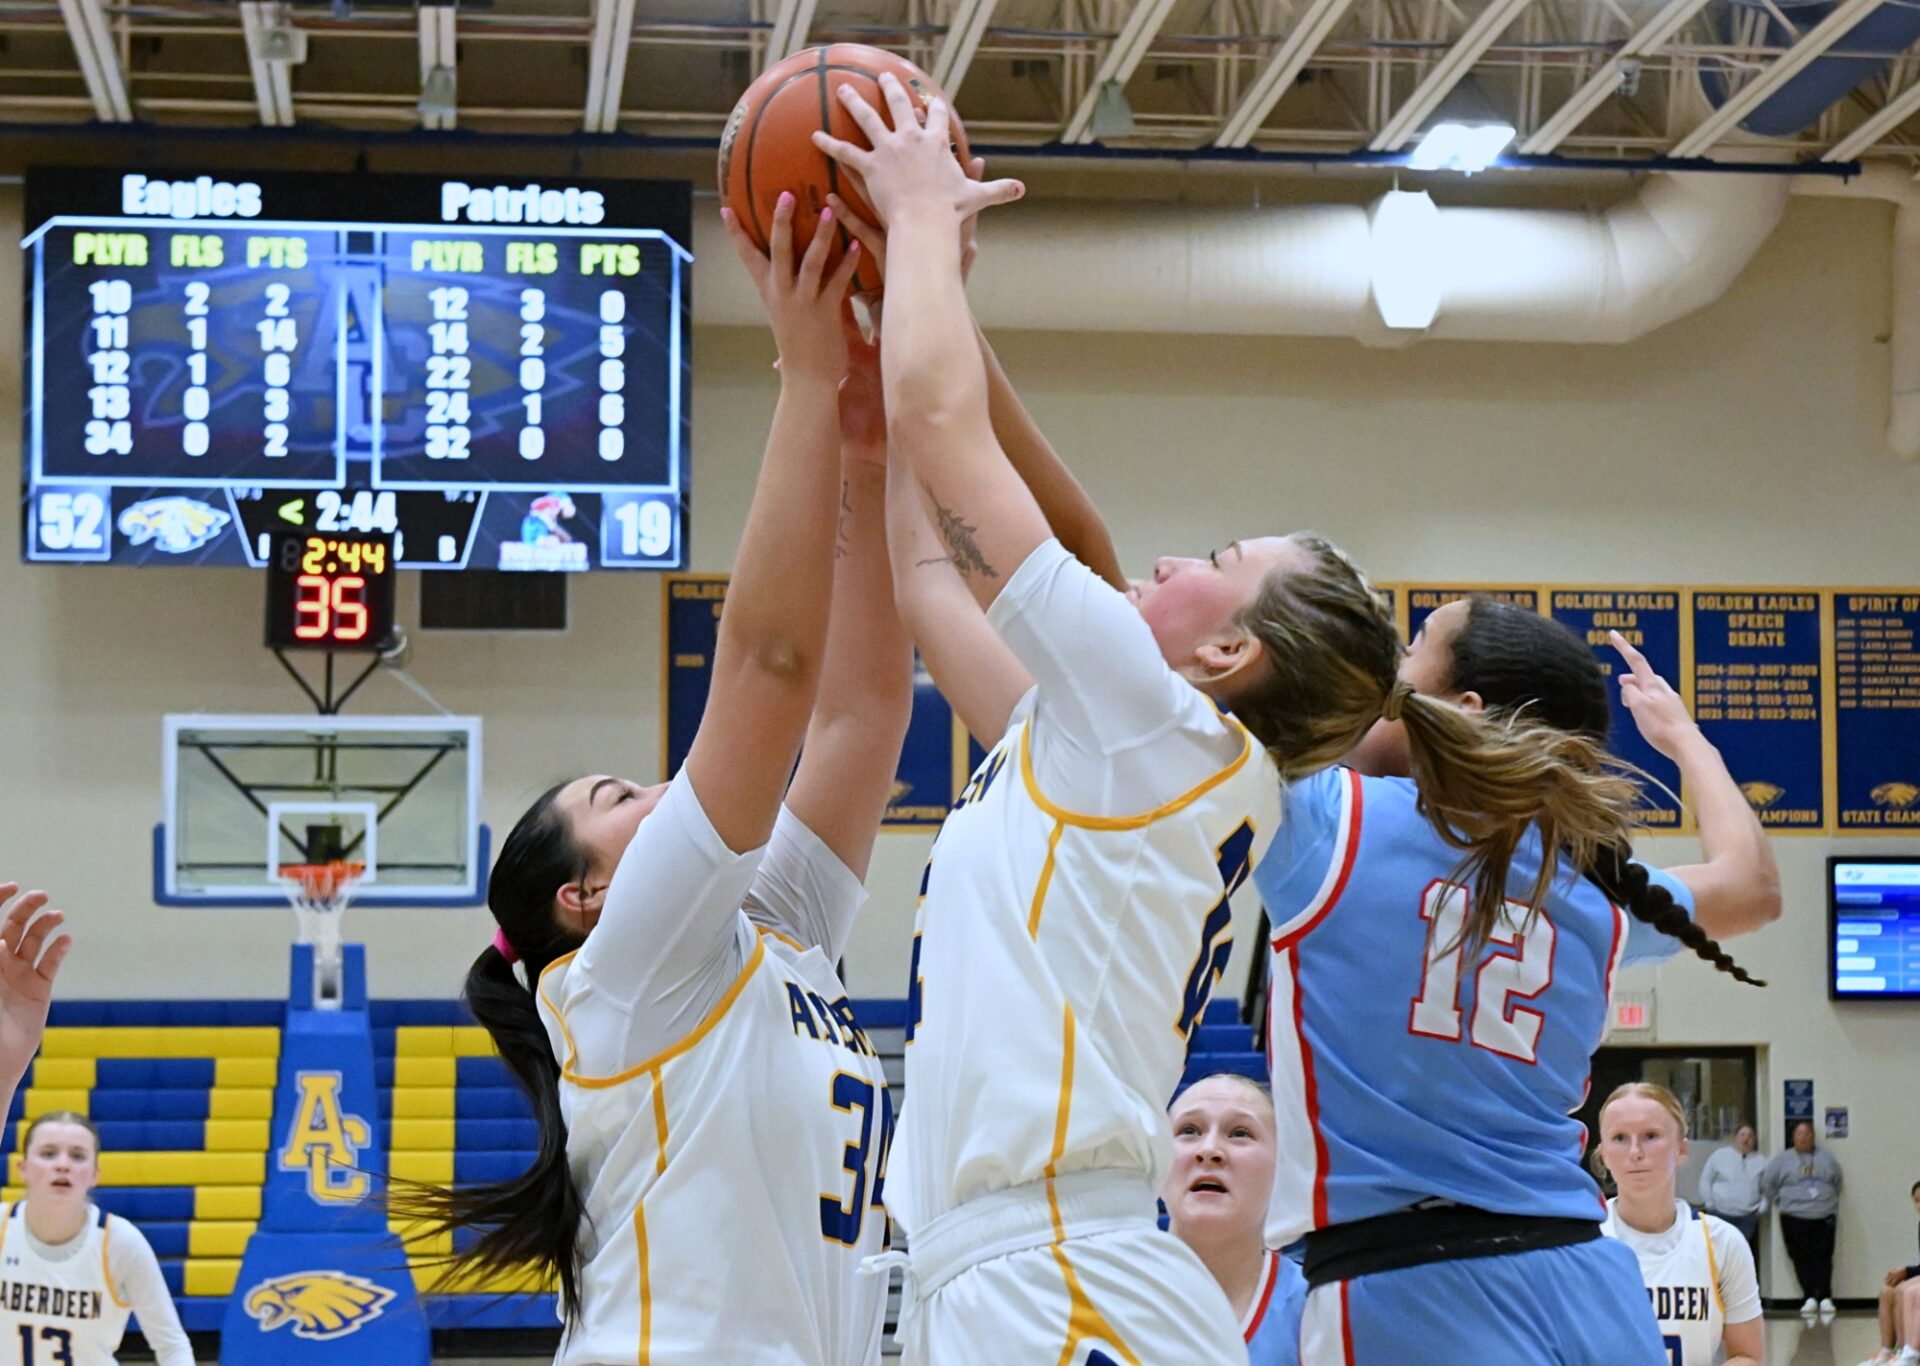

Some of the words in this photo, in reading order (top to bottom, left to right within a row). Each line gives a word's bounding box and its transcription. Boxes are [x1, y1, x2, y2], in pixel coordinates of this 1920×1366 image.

[122, 174, 262, 219] Eagles
[441, 182, 605, 224] Patriots
[73, 232, 148, 266] PLYR
[170, 234, 224, 267] FLS
[247, 236, 308, 269] PTS
[411, 240, 484, 272] PLYR
[506, 242, 558, 274] FLS
[580, 244, 641, 276] PTS
[88, 280, 132, 314] 10
[184, 281, 210, 315] 2
[265, 283, 290, 317] 2
[428, 287, 469, 320] 12
[520, 288, 545, 322] 3
[600, 290, 625, 323] 0
[91, 315, 128, 349] 11
[187, 317, 207, 350] 1
[256, 318, 298, 352] 14
[428, 322, 469, 354] 14
[520, 323, 545, 356] 2
[600, 325, 625, 358] 5
[88, 350, 130, 384] 12
[187, 352, 207, 385] 1
[425, 355, 471, 389] 22
[519, 357, 545, 391] 0
[87, 385, 130, 419] 13
[183, 386, 210, 421] 0
[264, 388, 289, 422] 3
[425, 390, 471, 424] 24
[521, 392, 541, 425] 1
[84, 420, 133, 455] 34
[183, 421, 210, 456] 0
[263, 423, 289, 457] 2
[424, 425, 471, 459] 32
[519, 426, 545, 460] 0
[598, 427, 625, 461] 0
[40, 493, 104, 549] 52
[316, 491, 398, 533] 2:44
[614, 501, 671, 556] 19
[302, 537, 385, 574] 2:44
[294, 575, 367, 640] 35
[1554, 594, 1612, 609] GOLDEN
[1617, 594, 1674, 610] EAGLES
[1593, 612, 1637, 627] GIRLS
[1697, 596, 1754, 611] GOLDEN
[1758, 596, 1815, 612] EAGLES
[1849, 597, 1898, 612] SPIRIT
[1728, 614, 1785, 628] SPEECH
[1728, 632, 1785, 647] DEBATE
[1842, 809, 1881, 823] STATE
[1408, 877, 1558, 1066] 12
[0, 1280, 103, 1320] ABERDEEN
[17, 1324, 74, 1366] 13
